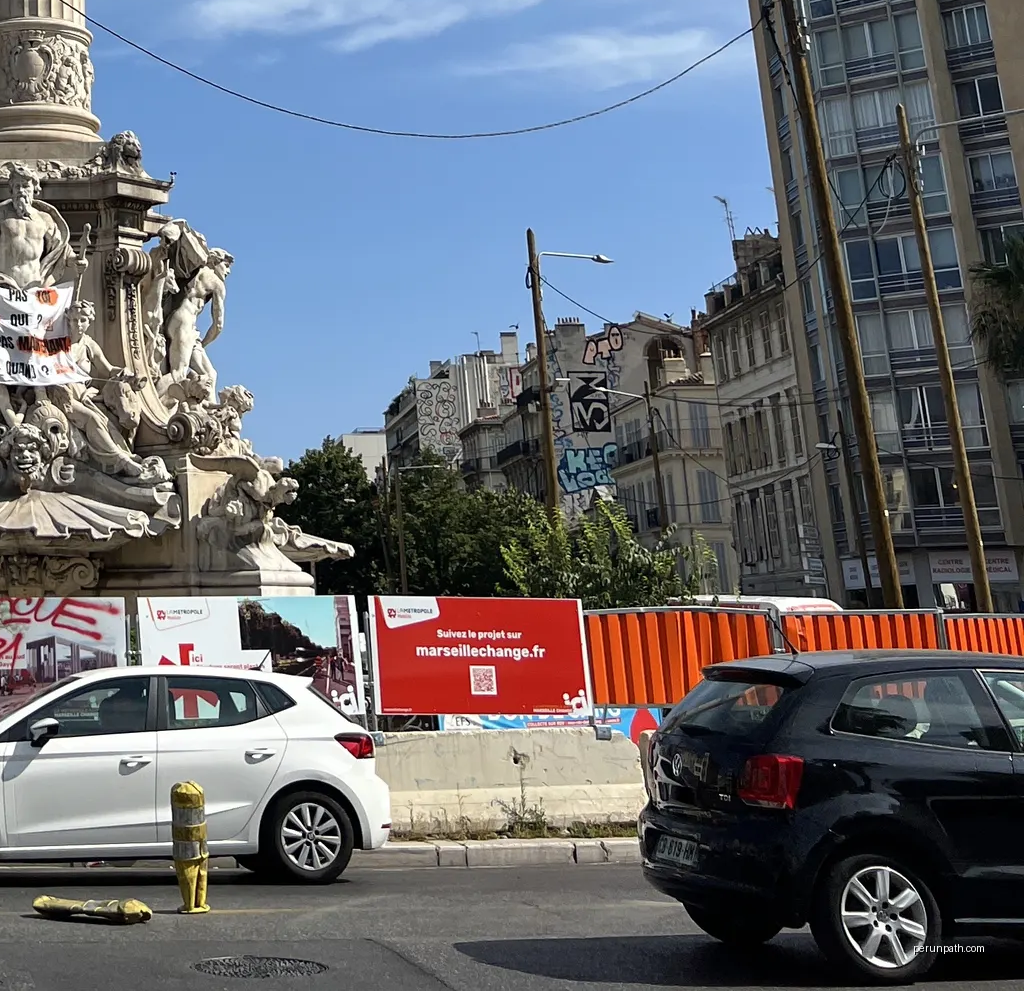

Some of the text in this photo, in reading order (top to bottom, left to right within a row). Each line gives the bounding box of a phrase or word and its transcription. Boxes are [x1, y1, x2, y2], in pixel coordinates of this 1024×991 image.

[8, 289, 28, 302] PAS
[10, 313, 43, 326] QUI ?
[41, 364, 50, 376] ?
[937, 558, 963, 566] CENTRE
[932, 566, 971, 574] RADIOLOGIE
[437, 629, 467, 638] Suivez
[468, 630, 476, 639] le
[478, 630, 505, 640] projet
[416, 644, 545, 661] marseillechange.fr
[191, 654, 203, 663] ici
[718, 793, 731, 802] TDI
